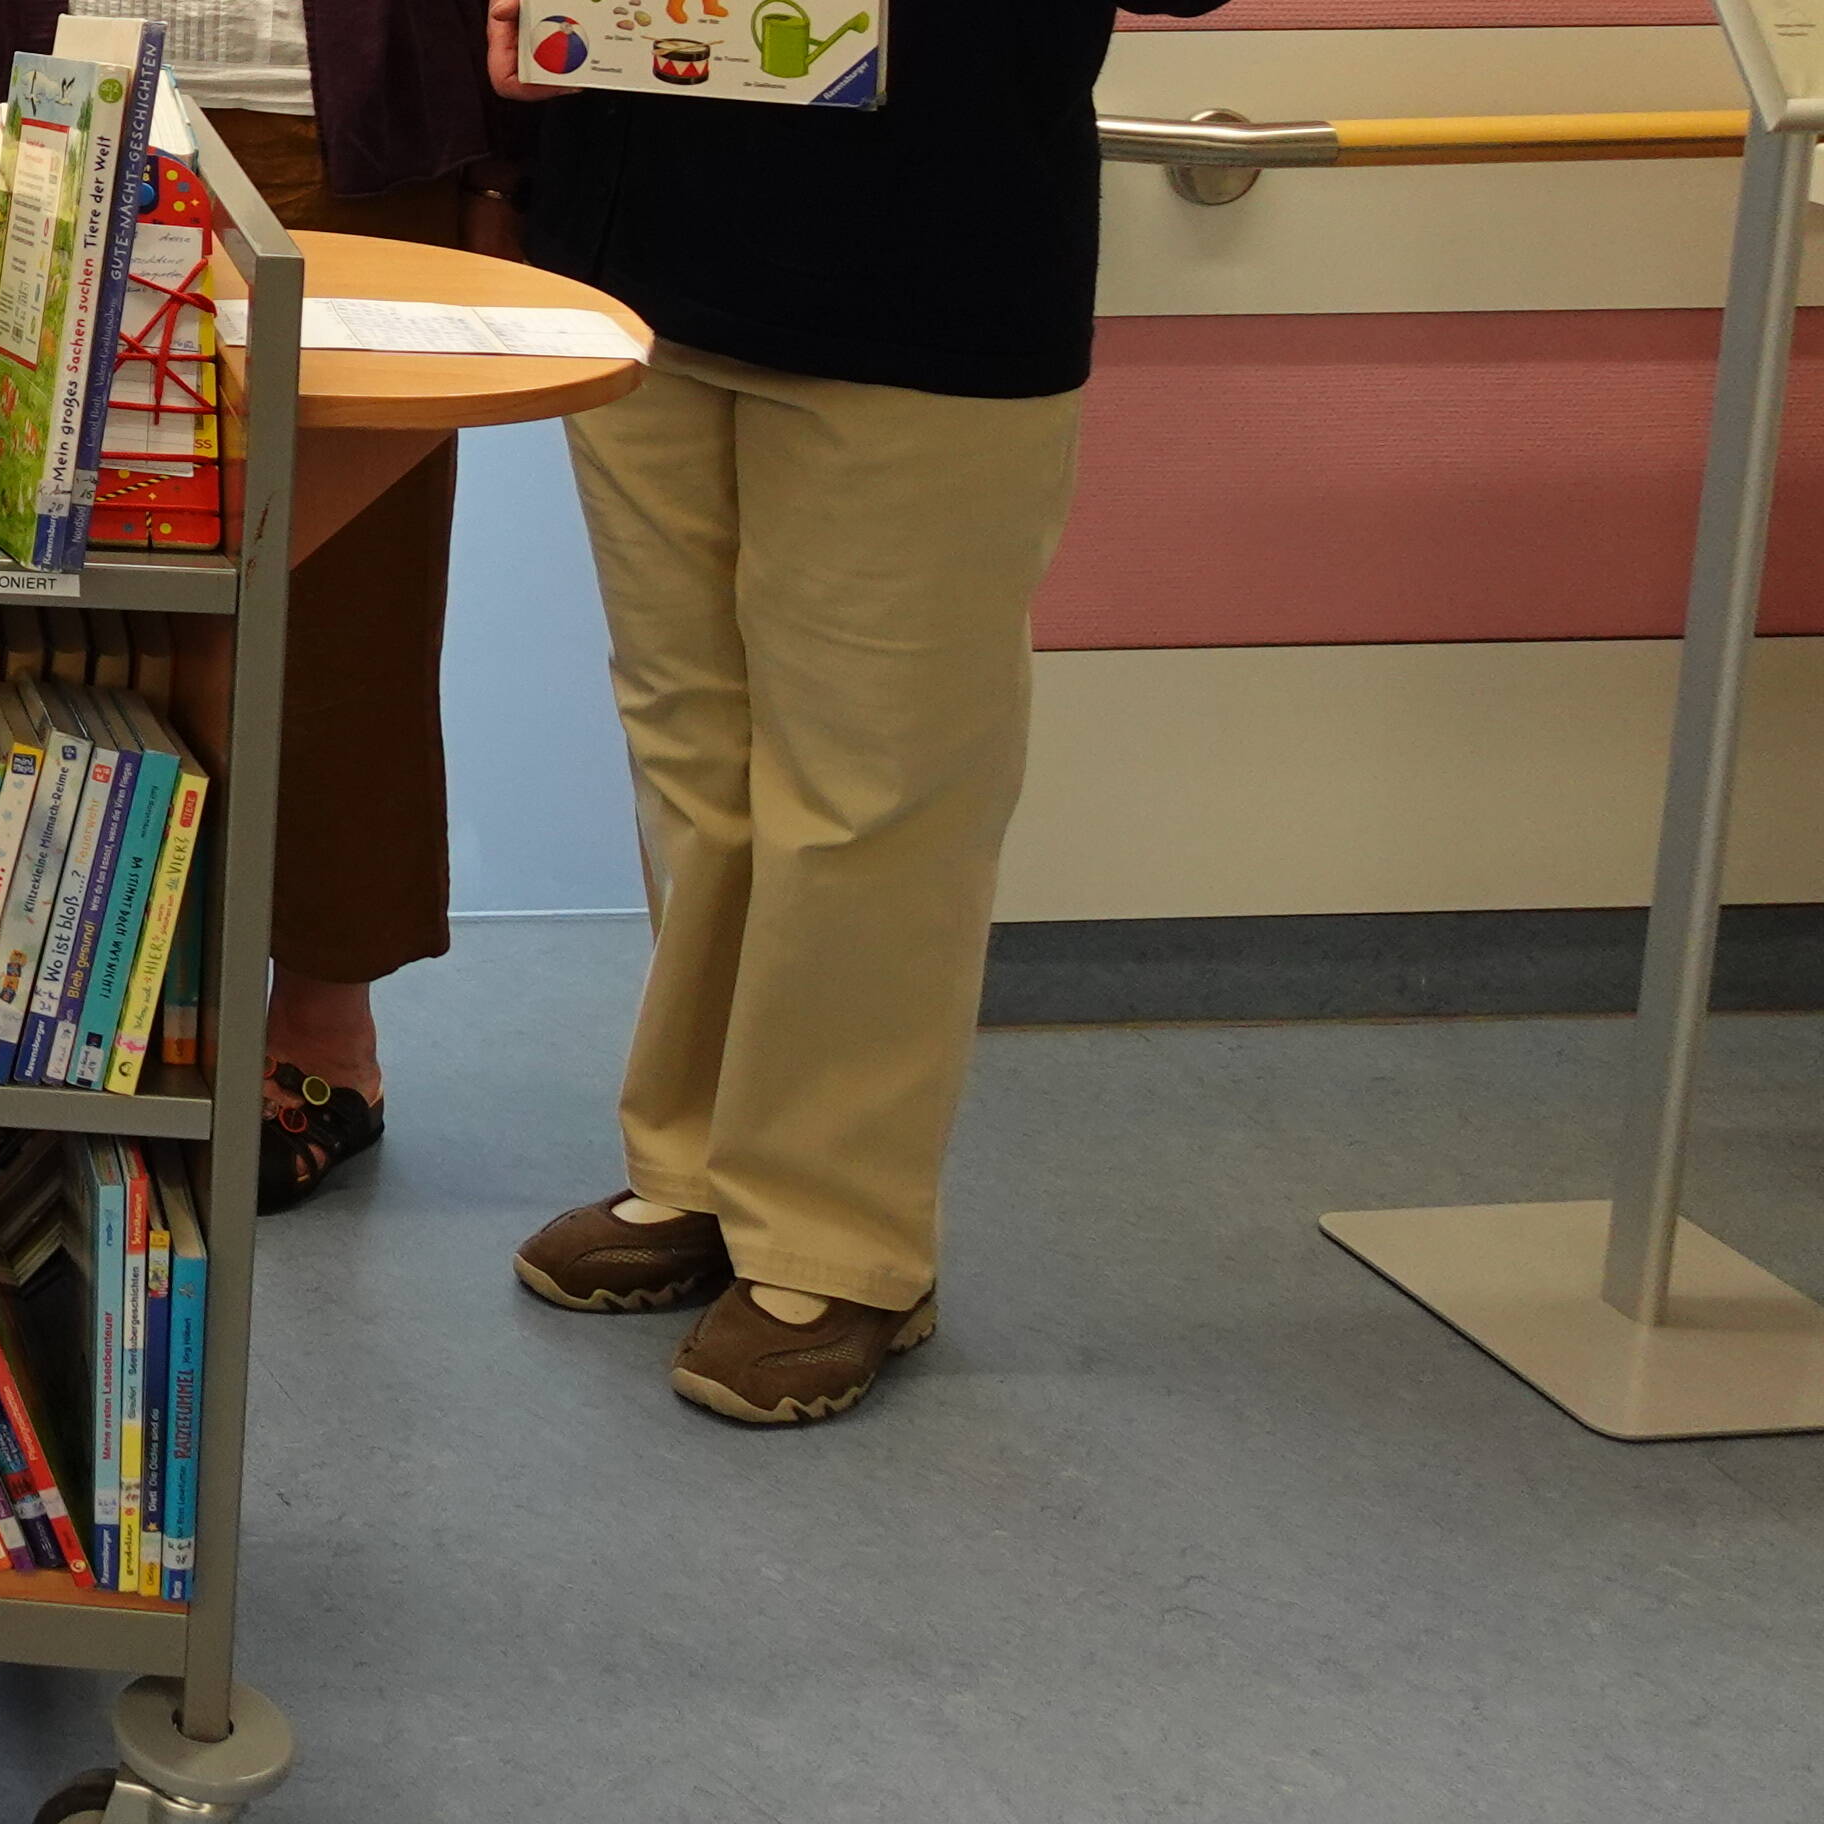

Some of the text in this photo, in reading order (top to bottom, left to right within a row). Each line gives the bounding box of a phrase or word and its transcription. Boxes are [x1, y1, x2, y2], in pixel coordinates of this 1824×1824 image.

[108, 41, 159, 281] GUTE-NACHT-GESCHICHTEN
[50, 135, 111, 482] Mein großes Sachen suchen Tiere der Welt
[56, 893, 81, 930] bloß
[51, 932, 70, 955] ist
[43, 957, 64, 984] Wo
